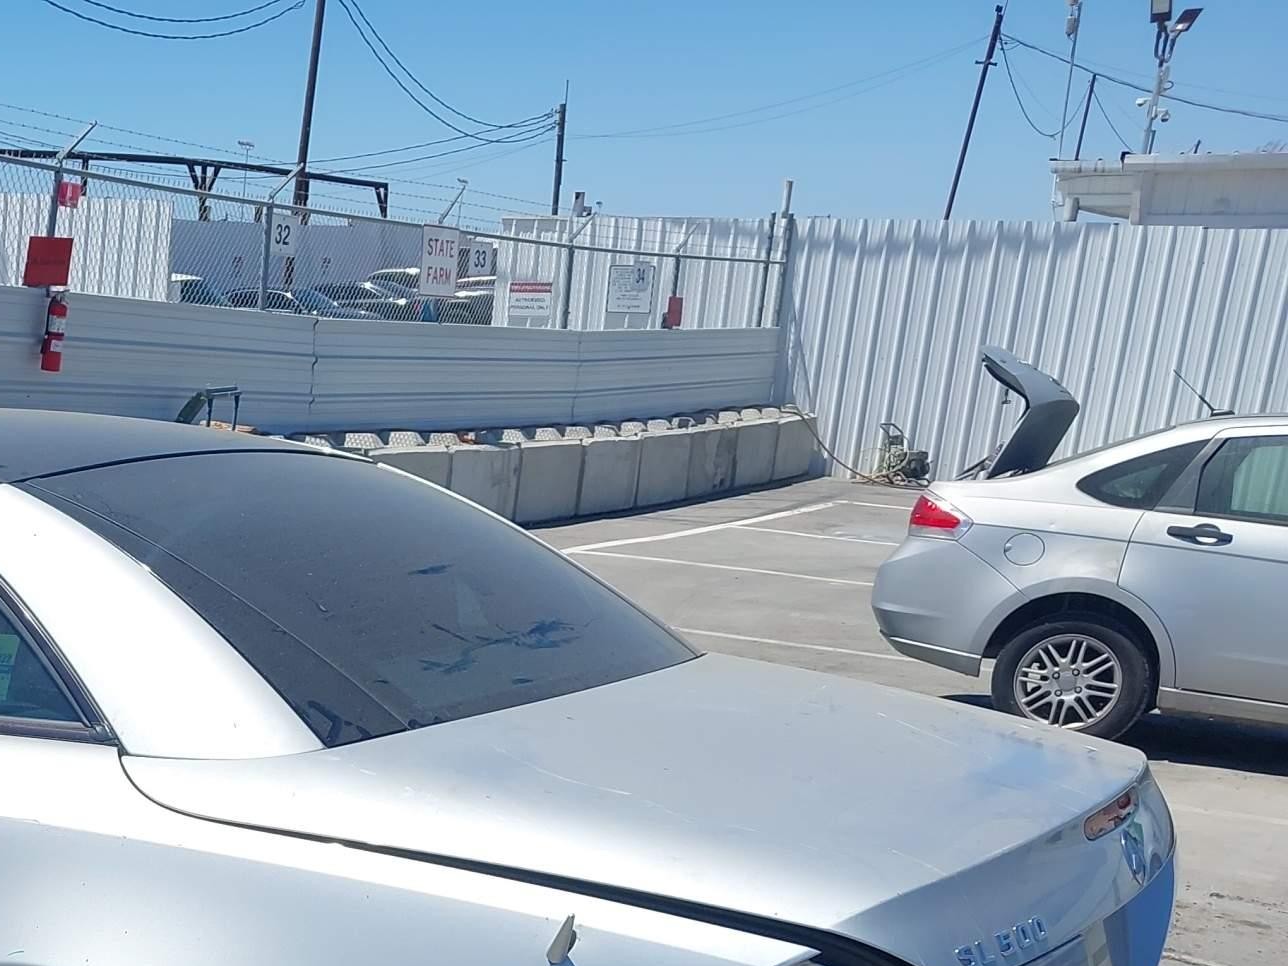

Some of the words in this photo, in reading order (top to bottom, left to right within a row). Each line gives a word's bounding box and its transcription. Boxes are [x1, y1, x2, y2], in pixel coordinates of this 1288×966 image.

[274, 223, 292, 246] 32
[427, 238, 455, 258] STATE
[473, 249, 487, 268] 33
[426, 266, 452, 285] FARM
[635, 267, 646, 284] 34
[993, 915, 1048, 957] 500
